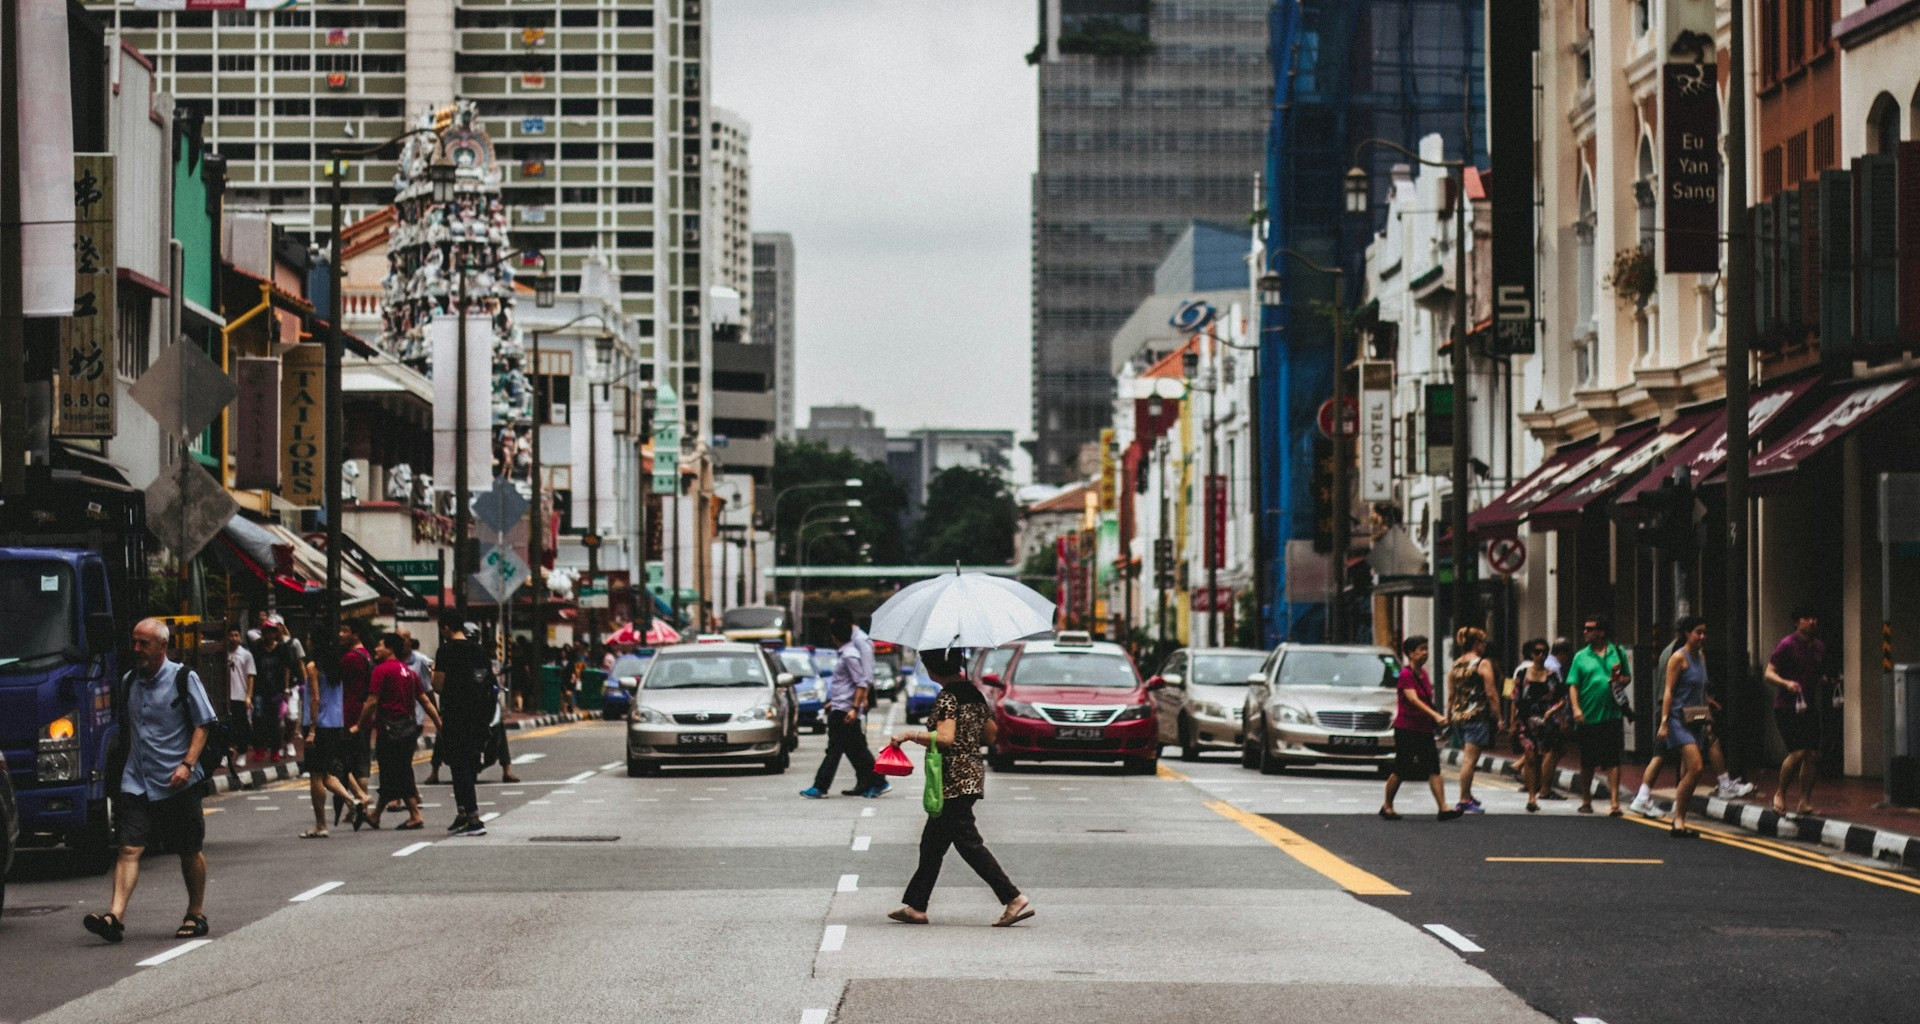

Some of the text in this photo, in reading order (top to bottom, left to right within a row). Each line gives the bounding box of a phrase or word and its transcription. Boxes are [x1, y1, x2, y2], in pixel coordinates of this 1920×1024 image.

[1682, 133, 1704, 150] Eu
[1679, 158, 1709, 175] Yan
[1672, 181, 1716, 204] Sang
[63, 392, 110, 408] B.B.Q
[289, 369, 317, 495] TAILORS
[1371, 403, 1383, 469] HOSTEL
[421, 562, 434, 573] St
